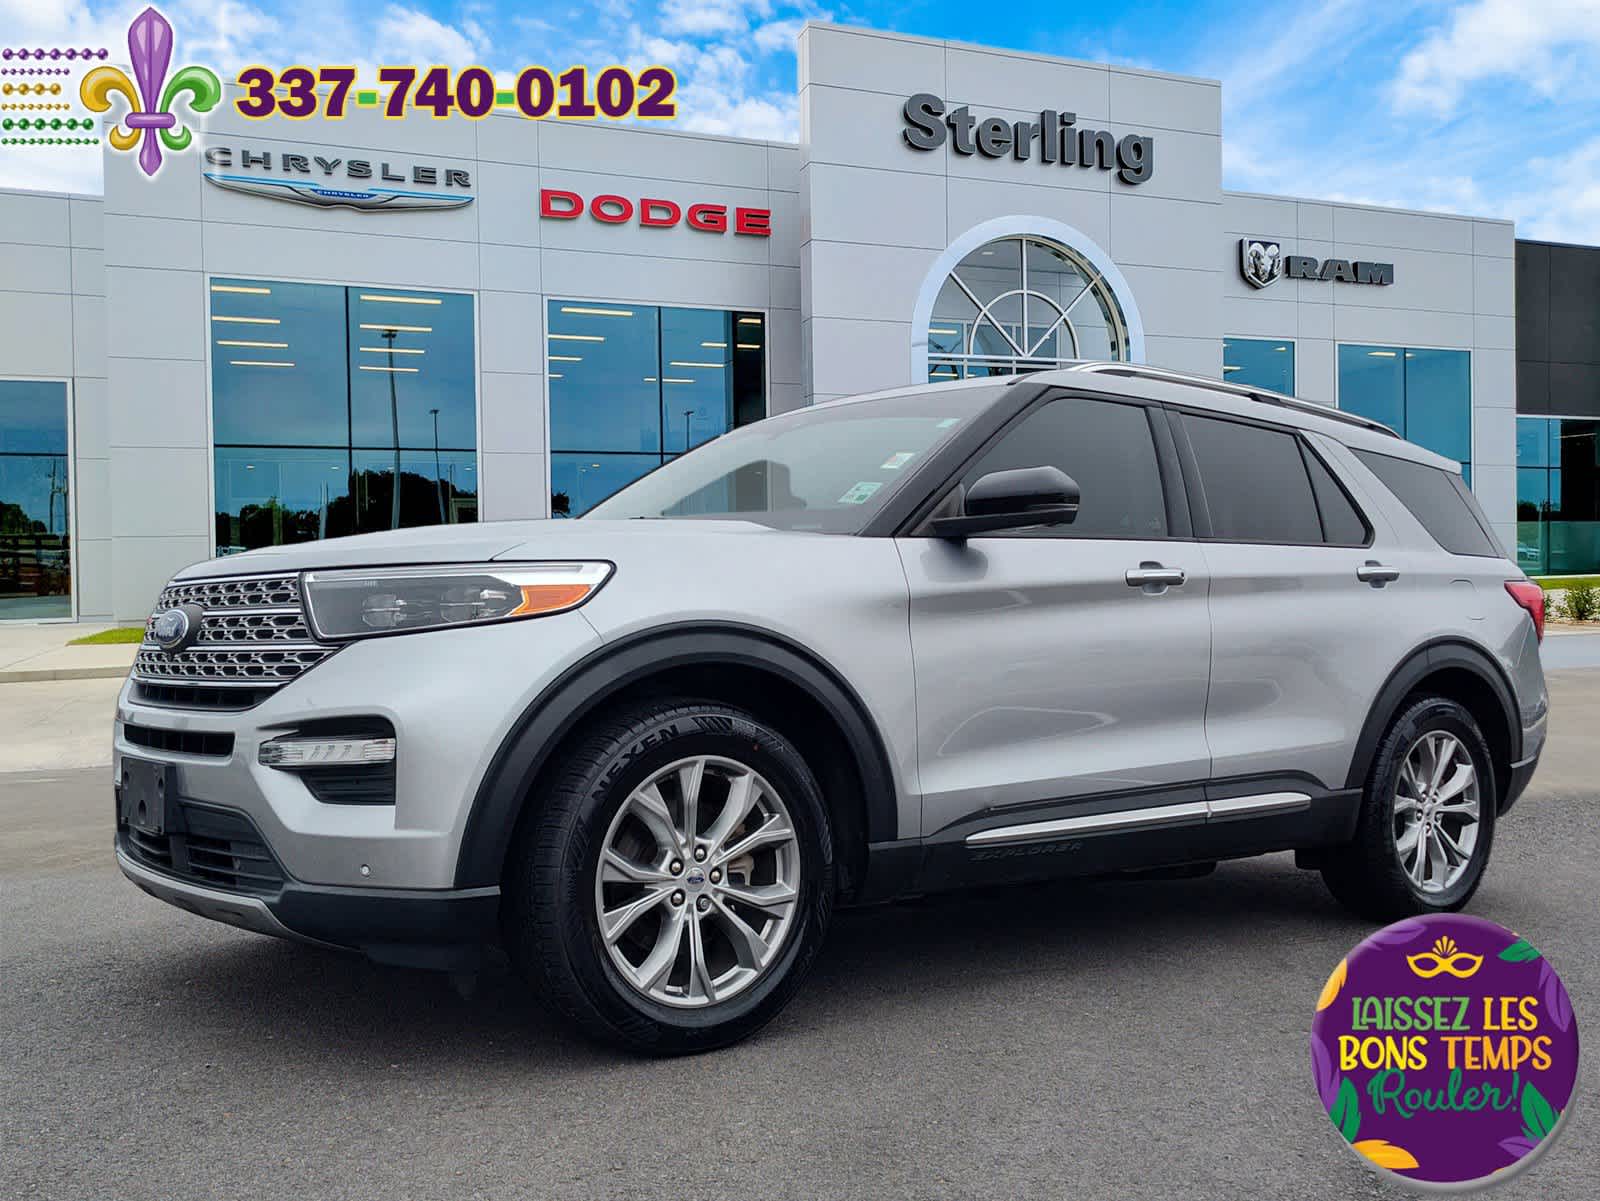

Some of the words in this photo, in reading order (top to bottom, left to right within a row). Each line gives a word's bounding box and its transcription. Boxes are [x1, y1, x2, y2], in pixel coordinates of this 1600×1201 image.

[902, 93, 1154, 185] Sterling
[205, 147, 471, 187] CHRYSLER
[540, 188, 771, 237] DODGE
[1285, 255, 1394, 286] RAM
[591, 724, 680, 800] NEXEN
